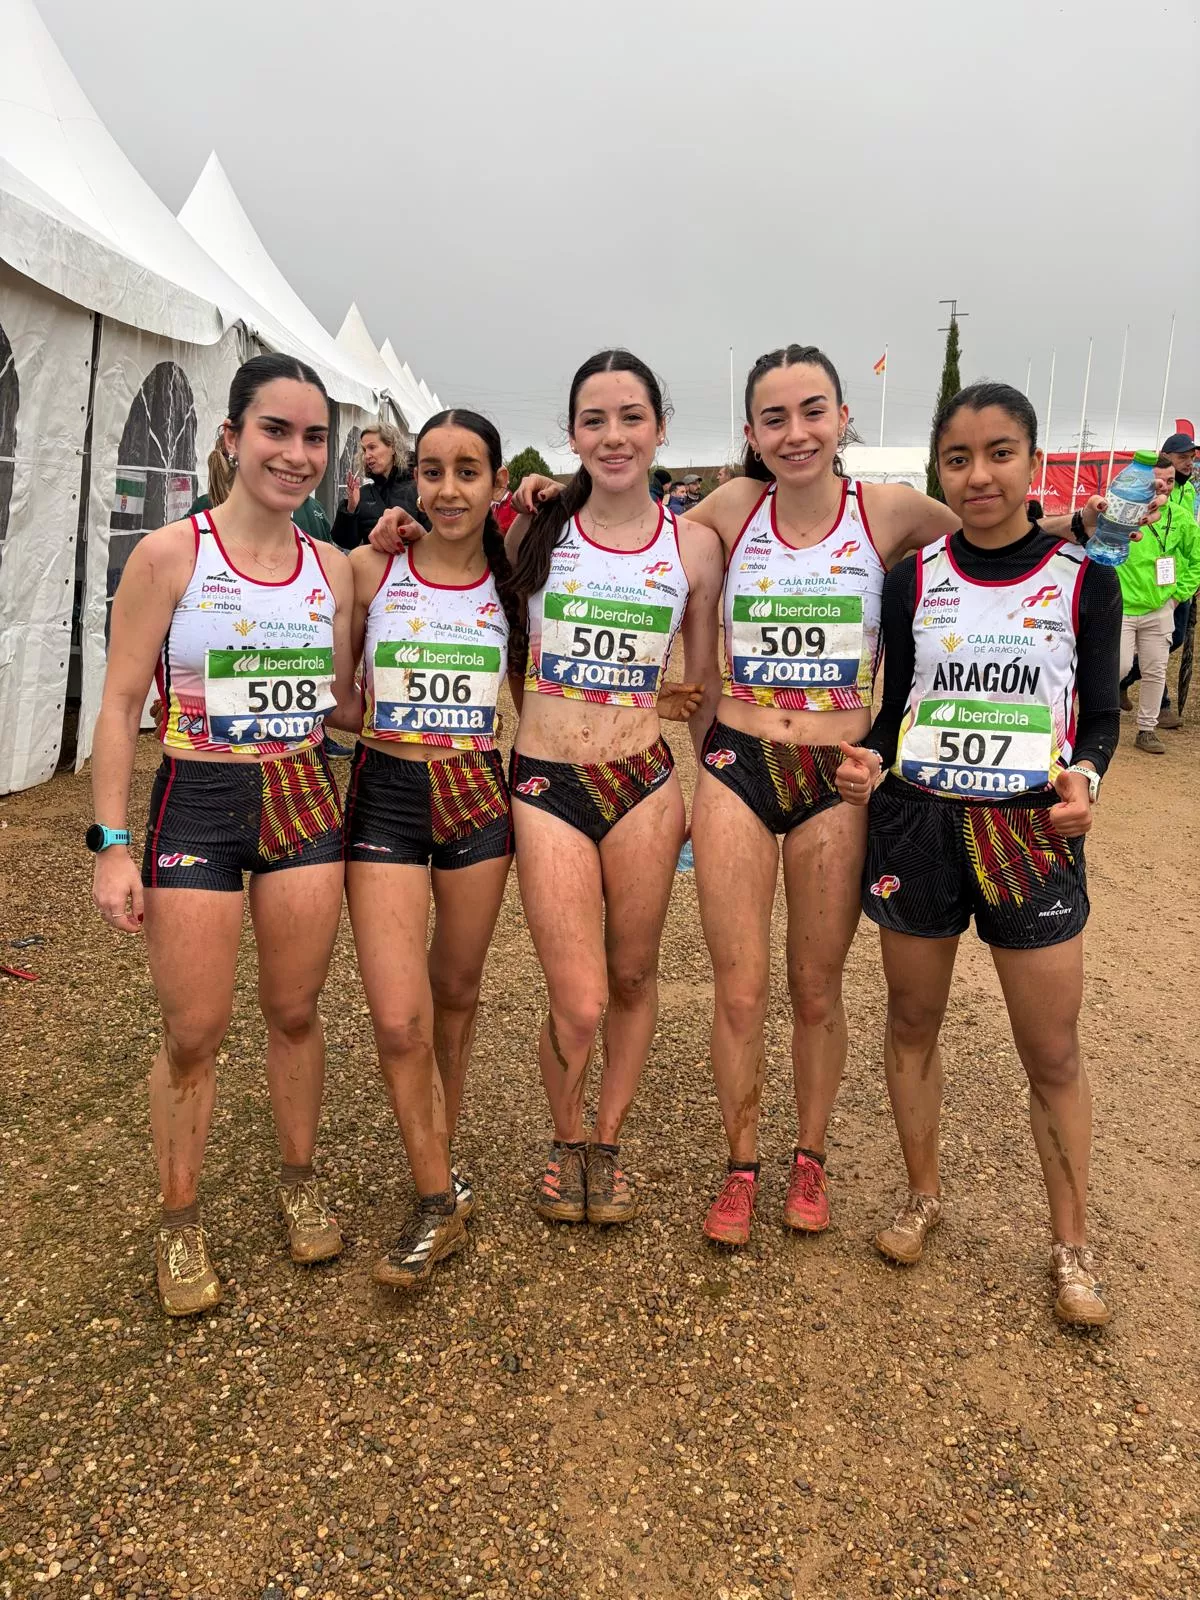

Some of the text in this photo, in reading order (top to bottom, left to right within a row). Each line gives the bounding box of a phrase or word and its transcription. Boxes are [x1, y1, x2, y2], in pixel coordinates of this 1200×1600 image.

[744, 544, 772, 555] belsue
[740, 562, 766, 570] embou
[202, 582, 240, 594] belsue
[778, 576, 838, 586] CAJA RURAL
[386, 589, 418, 598] belsue
[587, 582, 648, 597] CAJA RURAL
[201, 601, 241, 611] embou
[384, 603, 416, 612] embou
[924, 597, 960, 608] belsue
[590, 605, 653, 626] Iberdrola
[776, 604, 840, 617] Iberdrola
[260, 621, 319, 633] CAJA RURAL
[924, 614, 956, 626] embou
[430, 622, 452, 631] CAJA
[455, 624, 485, 637] RURAL
[572, 627, 637, 663] 505
[761, 626, 826, 657] 509
[968, 634, 1036, 646] CAJA RURAL
[988, 646, 1027, 655] ARAGÓN
[263, 656, 324, 670] Iberdrola
[423, 651, 484, 666] Iberdrola
[572, 662, 645, 687] Joma
[762, 662, 842, 682] Joma
[933, 657, 1040, 695] ARAGÓN
[408, 673, 471, 703] 506
[248, 680, 316, 713] 508
[411, 708, 485, 729] Joma
[958, 707, 1028, 726] Iberdrola
[938, 731, 1012, 766] 507
[940, 768, 1028, 792] Joma
[1039, 908, 1072, 917] MERCURY
